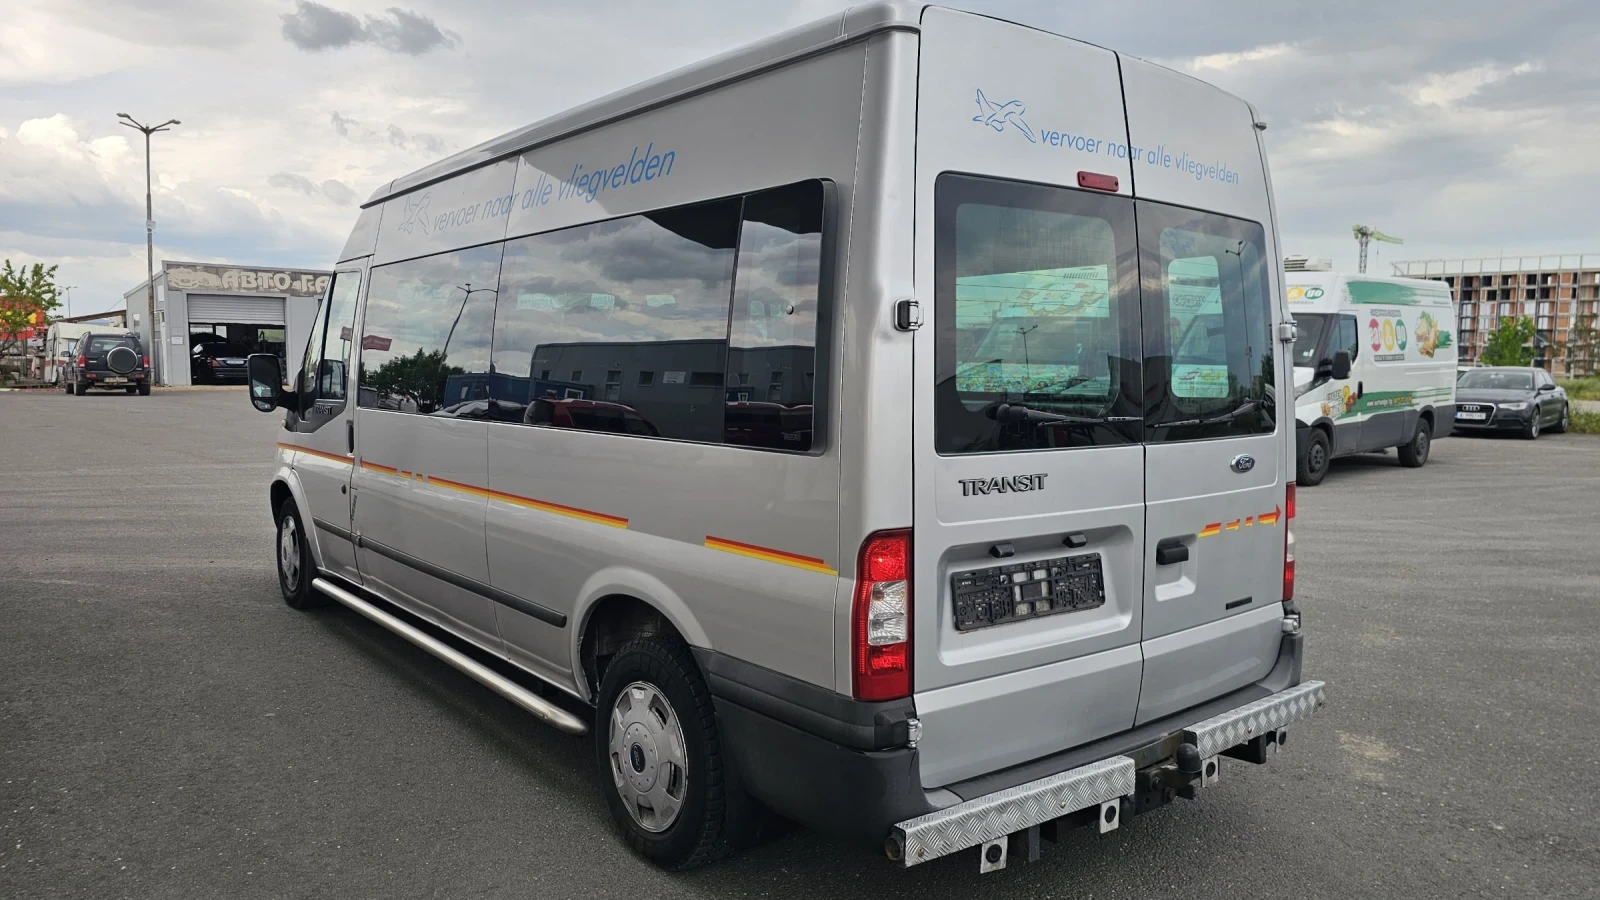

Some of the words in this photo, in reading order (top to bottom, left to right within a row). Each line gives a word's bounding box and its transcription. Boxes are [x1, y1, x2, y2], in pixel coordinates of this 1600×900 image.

[1041, 129, 1102, 154] vervoer
[1108, 143, 1142, 162] naar
[1148, 146, 1171, 168] alle
[1175, 154, 1239, 185] vliegvelden
[433, 204, 481, 231] vervoer
[482, 191, 519, 219] naar
[521, 173, 551, 209] alle
[557, 142, 676, 203] vliegvelden
[1238, 457, 1253, 469] Ford
[959, 473, 1048, 497] TRANSIT
